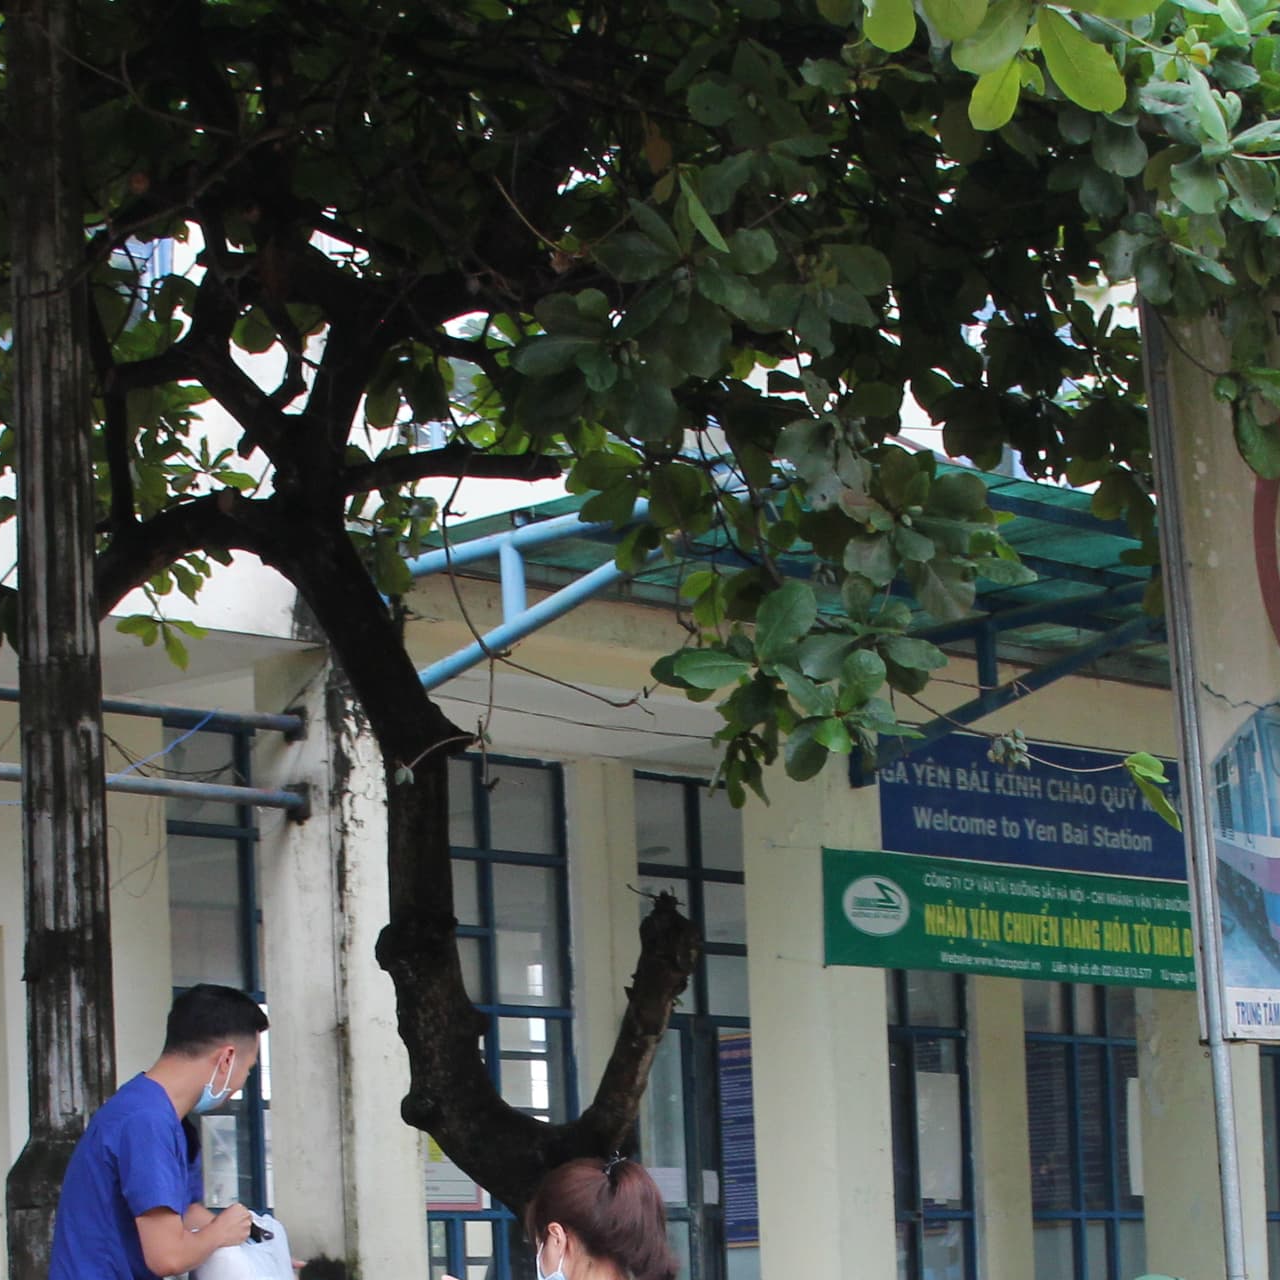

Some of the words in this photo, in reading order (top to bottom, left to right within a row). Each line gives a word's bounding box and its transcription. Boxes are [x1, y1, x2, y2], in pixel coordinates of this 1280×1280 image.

[912, 756, 951, 788] YÊN
[956, 762, 990, 793] BÁI
[1046, 774, 1097, 805] CHÀO
[913, 806, 998, 836] Welcome
[1001, 815, 1020, 839] to
[1023, 818, 1057, 842] Yen
[1062, 822, 1089, 846] Bai
[1093, 827, 1153, 852] Station
[1003, 903, 1059, 947] CHUYỂN
[1062, 911, 1100, 951] HÀNG
[1236, 1001, 1261, 1025] TRUNG
[1263, 997, 1280, 1025] TÂM
